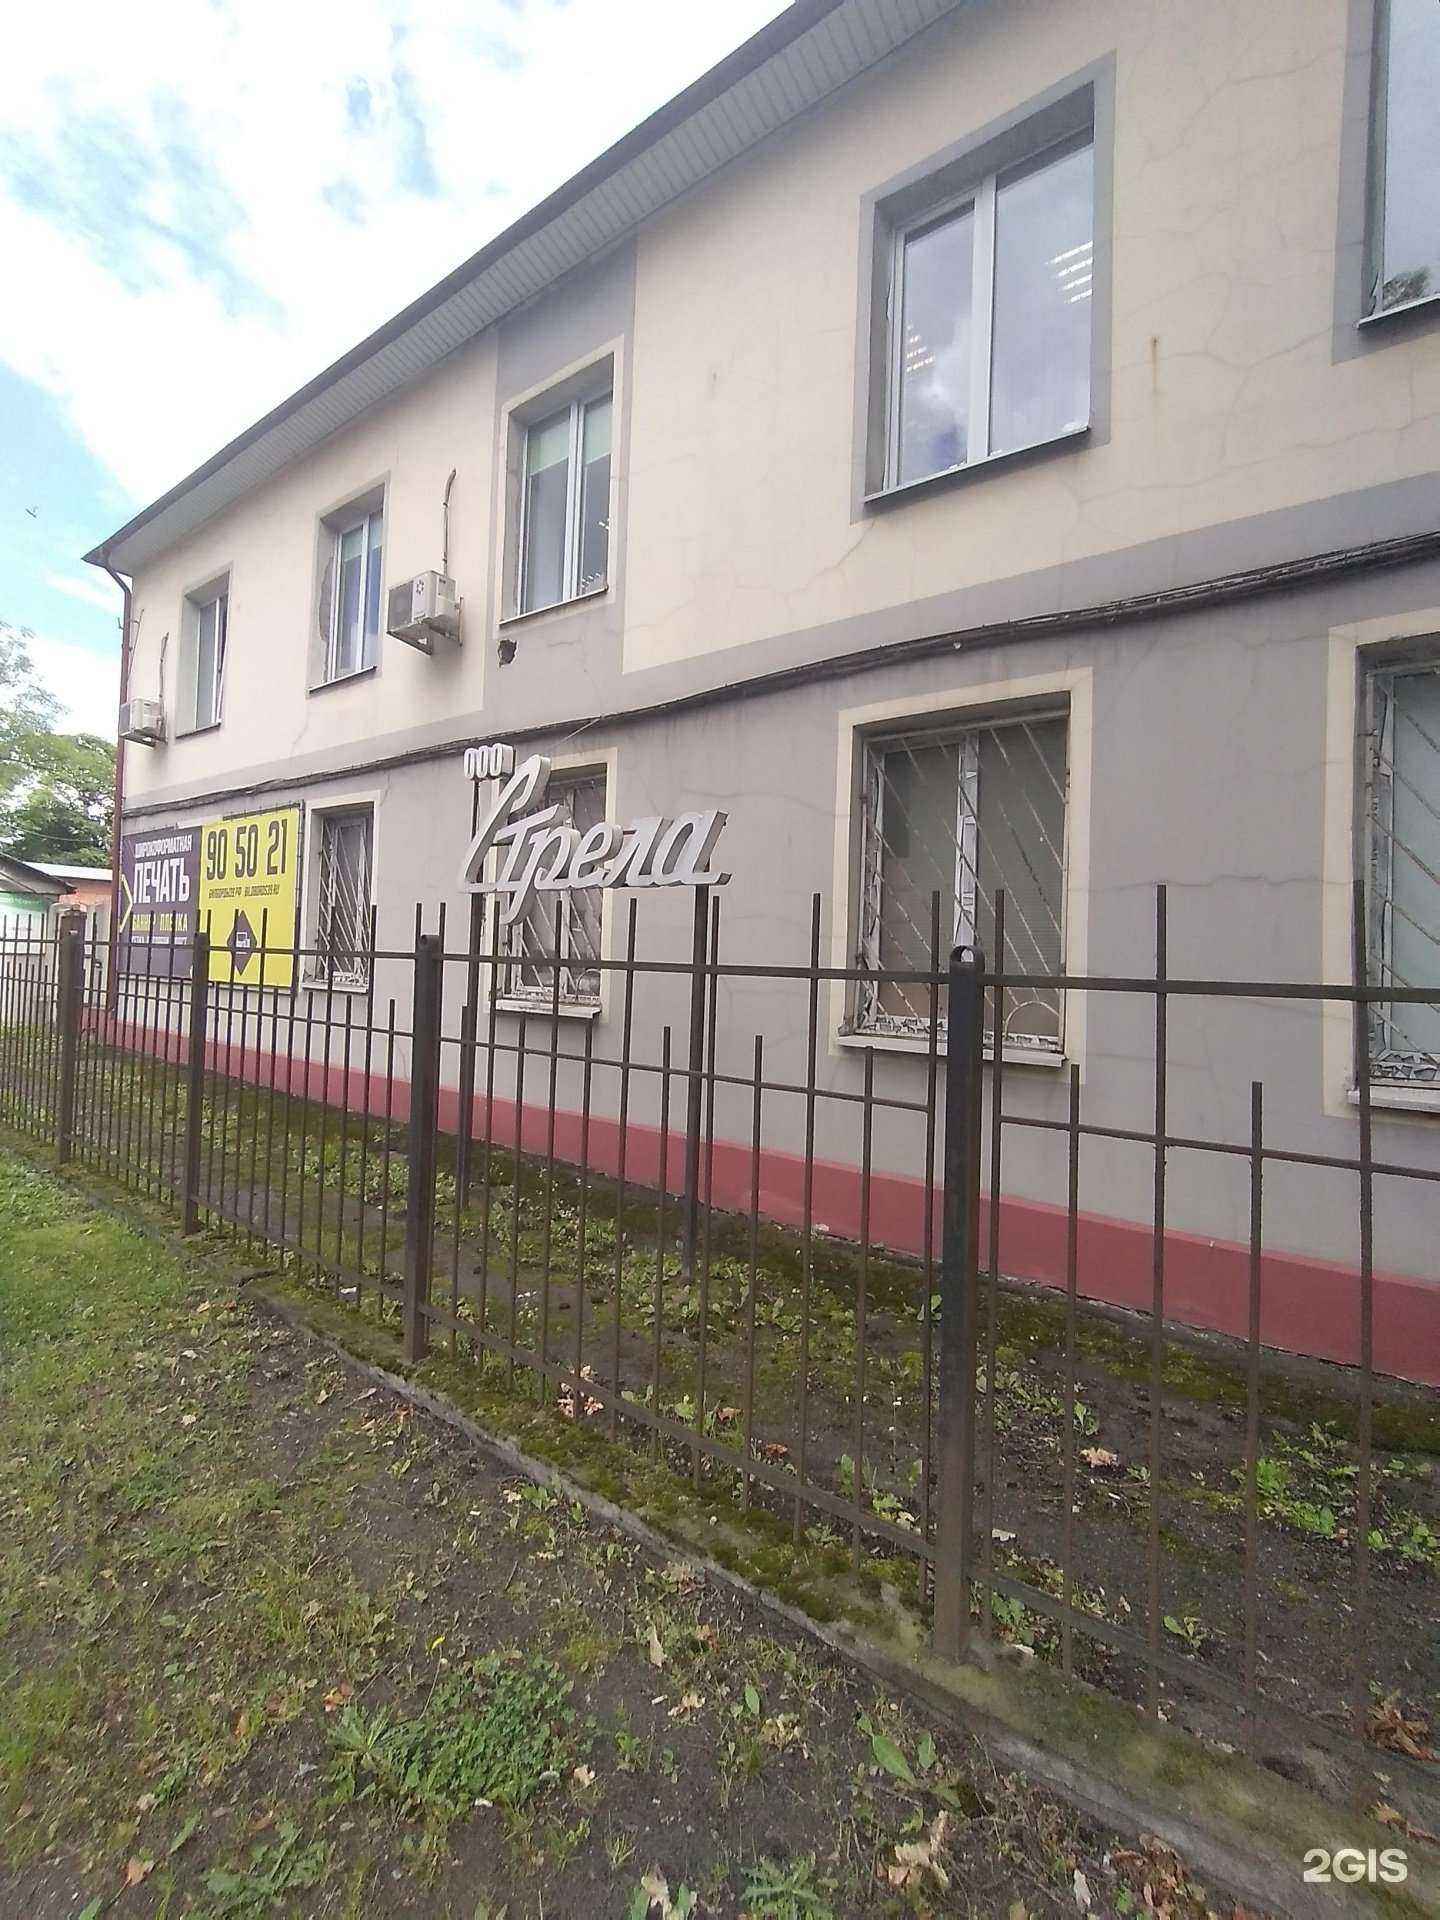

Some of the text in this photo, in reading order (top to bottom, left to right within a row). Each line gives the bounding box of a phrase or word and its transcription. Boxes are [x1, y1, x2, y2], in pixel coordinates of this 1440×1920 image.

[463, 743, 509, 779] ООО
[135, 835, 192, 858] ШИРОКОФОРМАТНАЯ
[206, 818, 288, 880] 90 50 21
[461, 754, 732, 925] Стрела
[133, 858, 190, 903] ПЕЧАТЬ
[133, 913, 156, 931] БАННР
